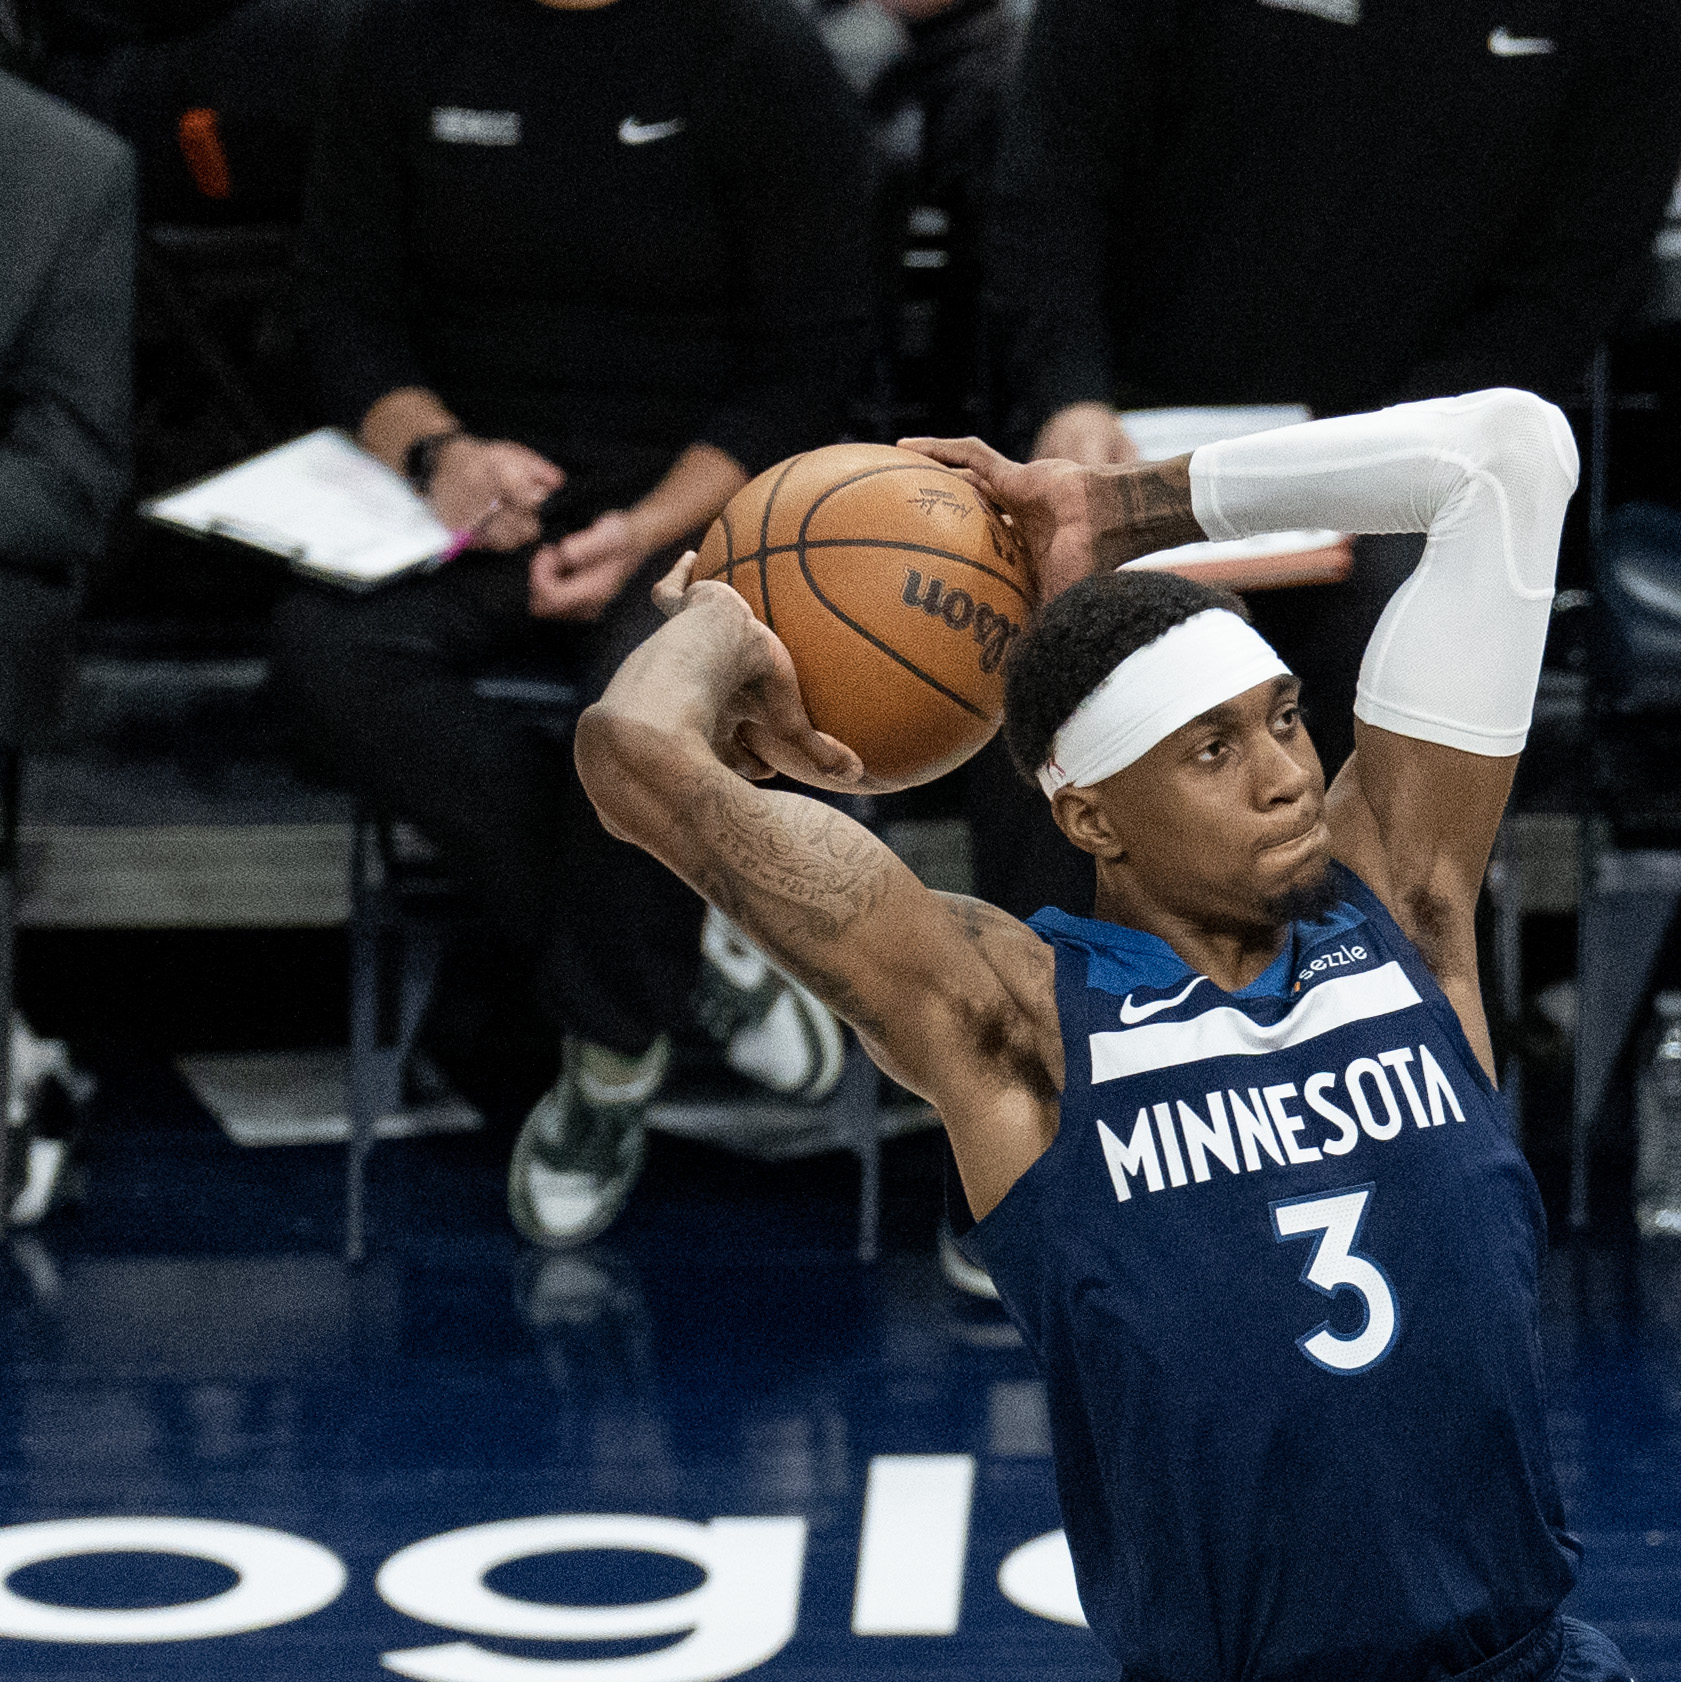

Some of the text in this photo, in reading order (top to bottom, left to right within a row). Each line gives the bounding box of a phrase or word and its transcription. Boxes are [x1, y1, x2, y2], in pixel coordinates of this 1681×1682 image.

[1299, 945, 1367, 980] sezzle
[1096, 1044, 1466, 1203] MINNESOTA
[1268, 1181, 1400, 1376] 3
